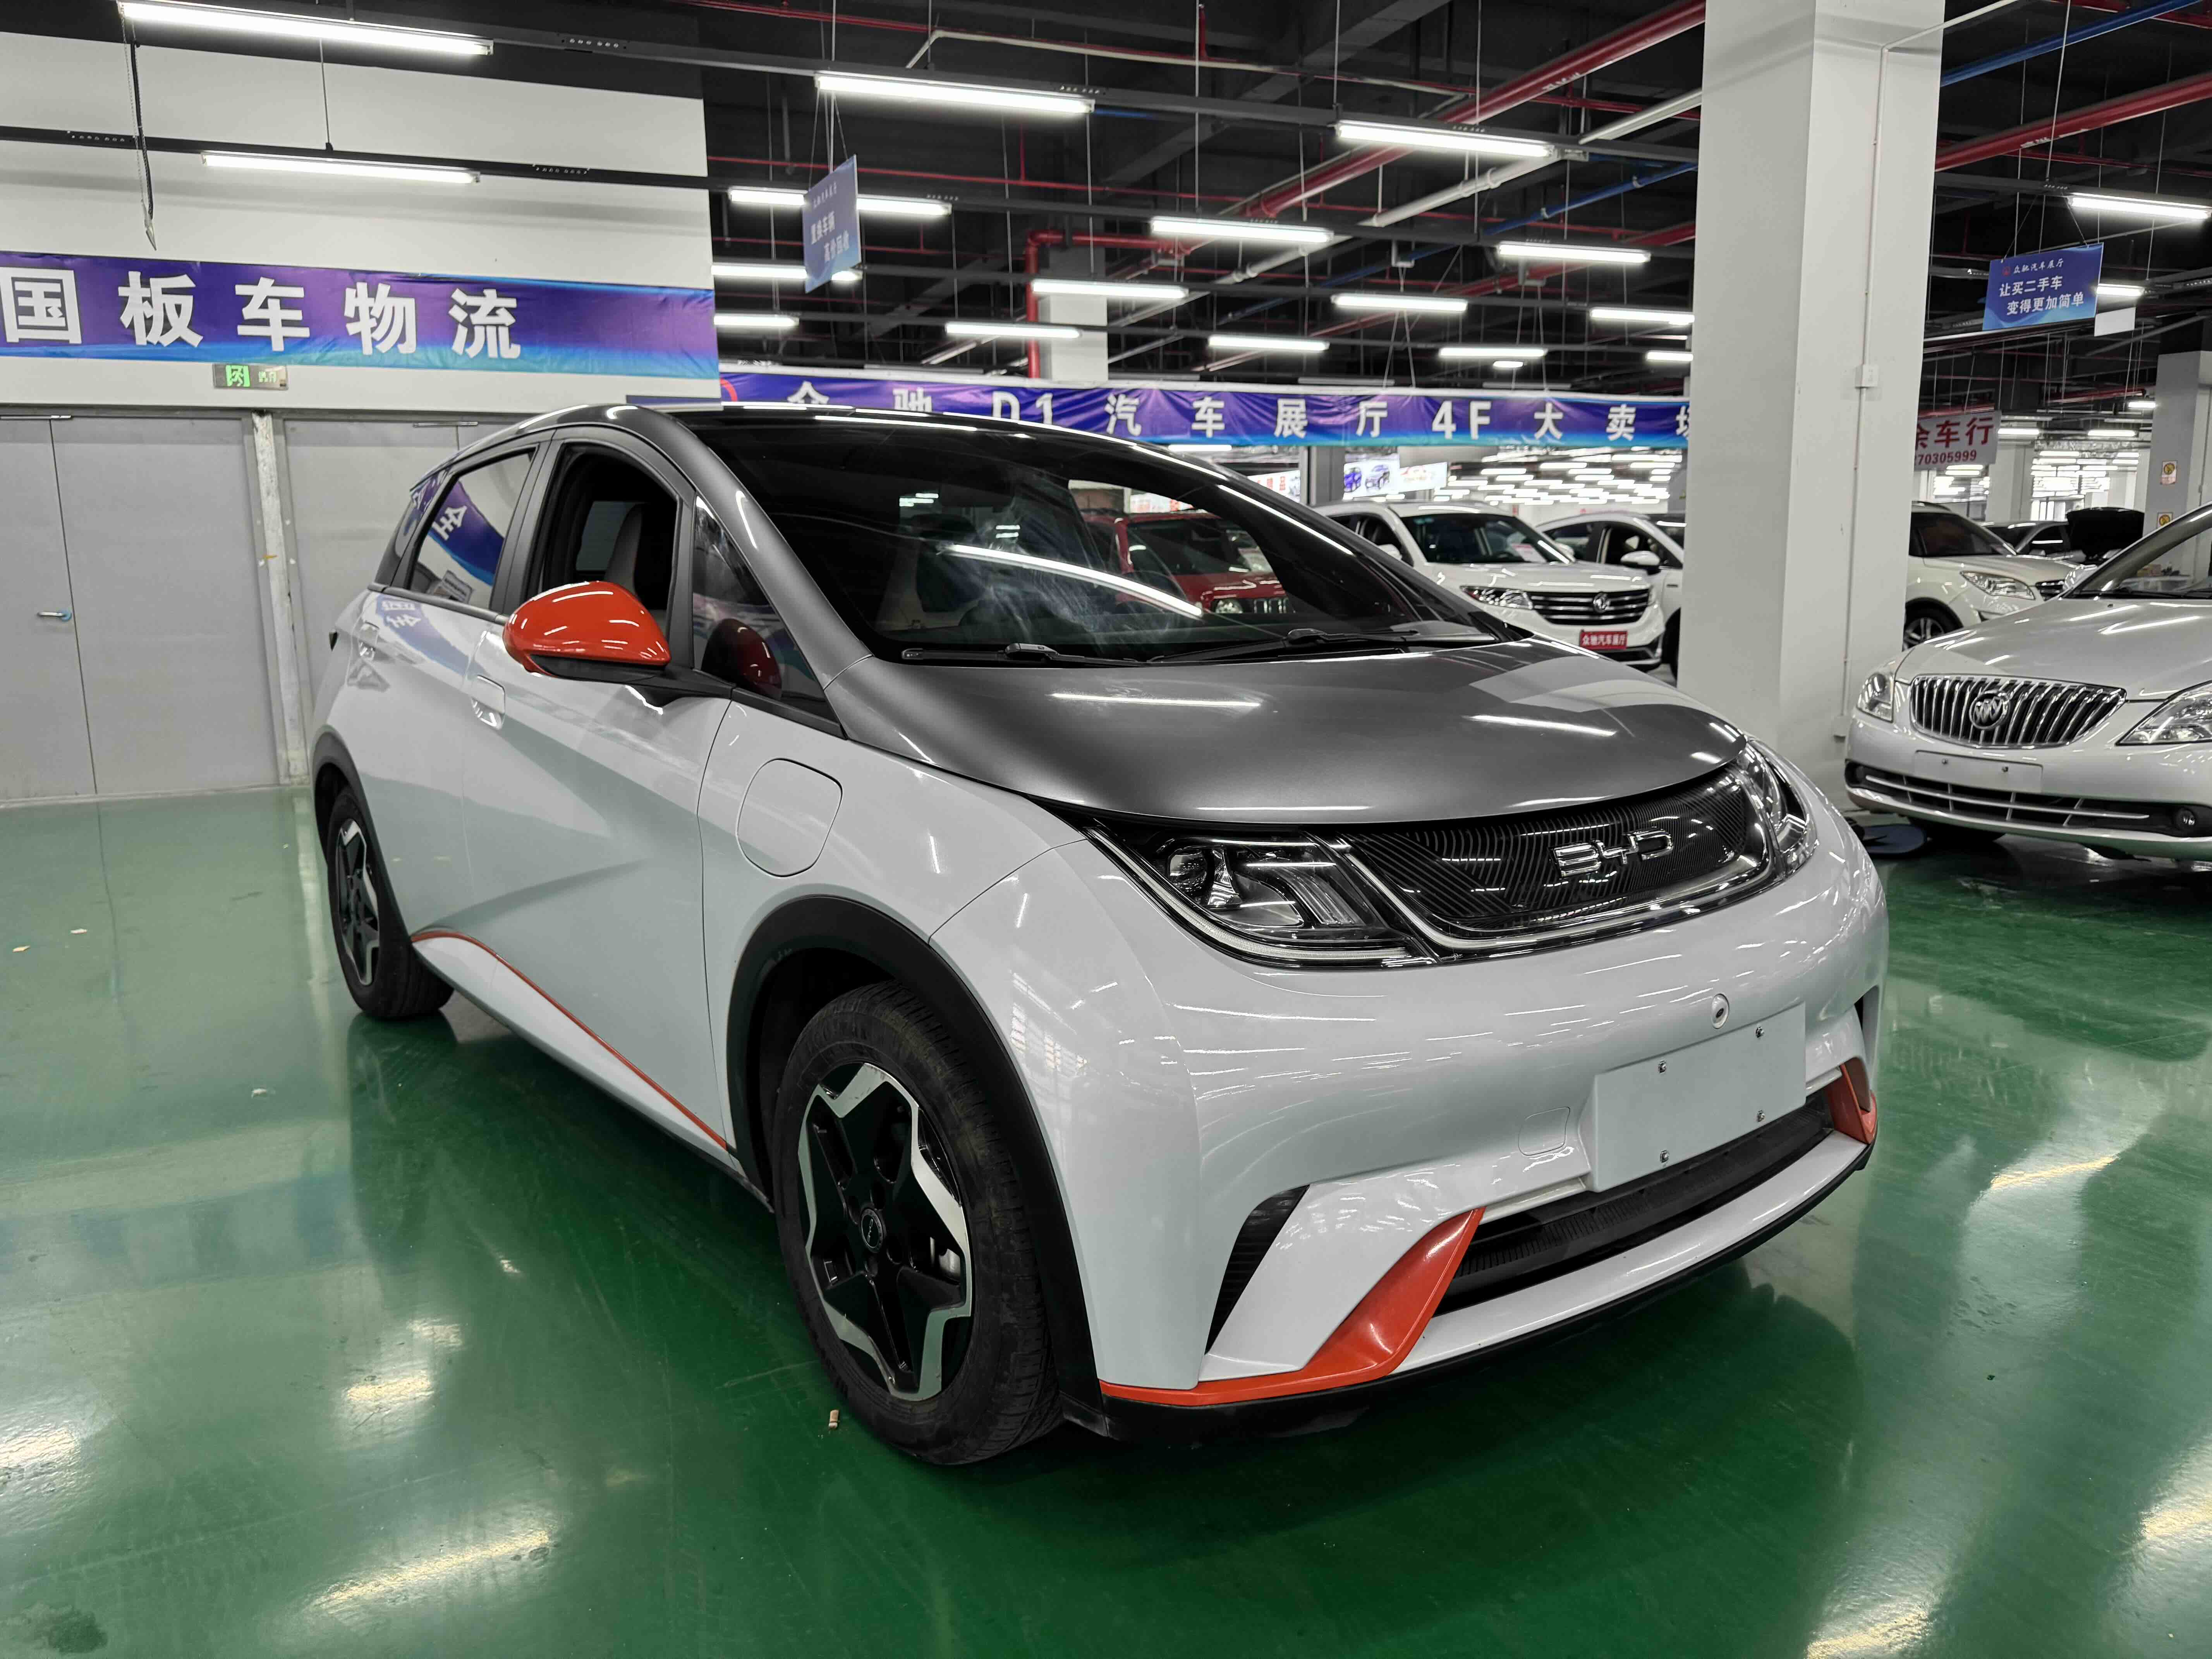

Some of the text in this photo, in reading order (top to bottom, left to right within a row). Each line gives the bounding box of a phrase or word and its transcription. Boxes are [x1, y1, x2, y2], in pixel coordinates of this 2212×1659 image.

[2013, 258, 2064, 274] 众驰汽车展厅
[1999, 275, 2063, 297] 让买二手车
[0, 267, 520, 359] 国板车物流
[2006, 292, 2084, 316] 变得更加简单
[1915, 449, 1977, 465] 70305999
[1552, 828, 1673, 878] BYD
